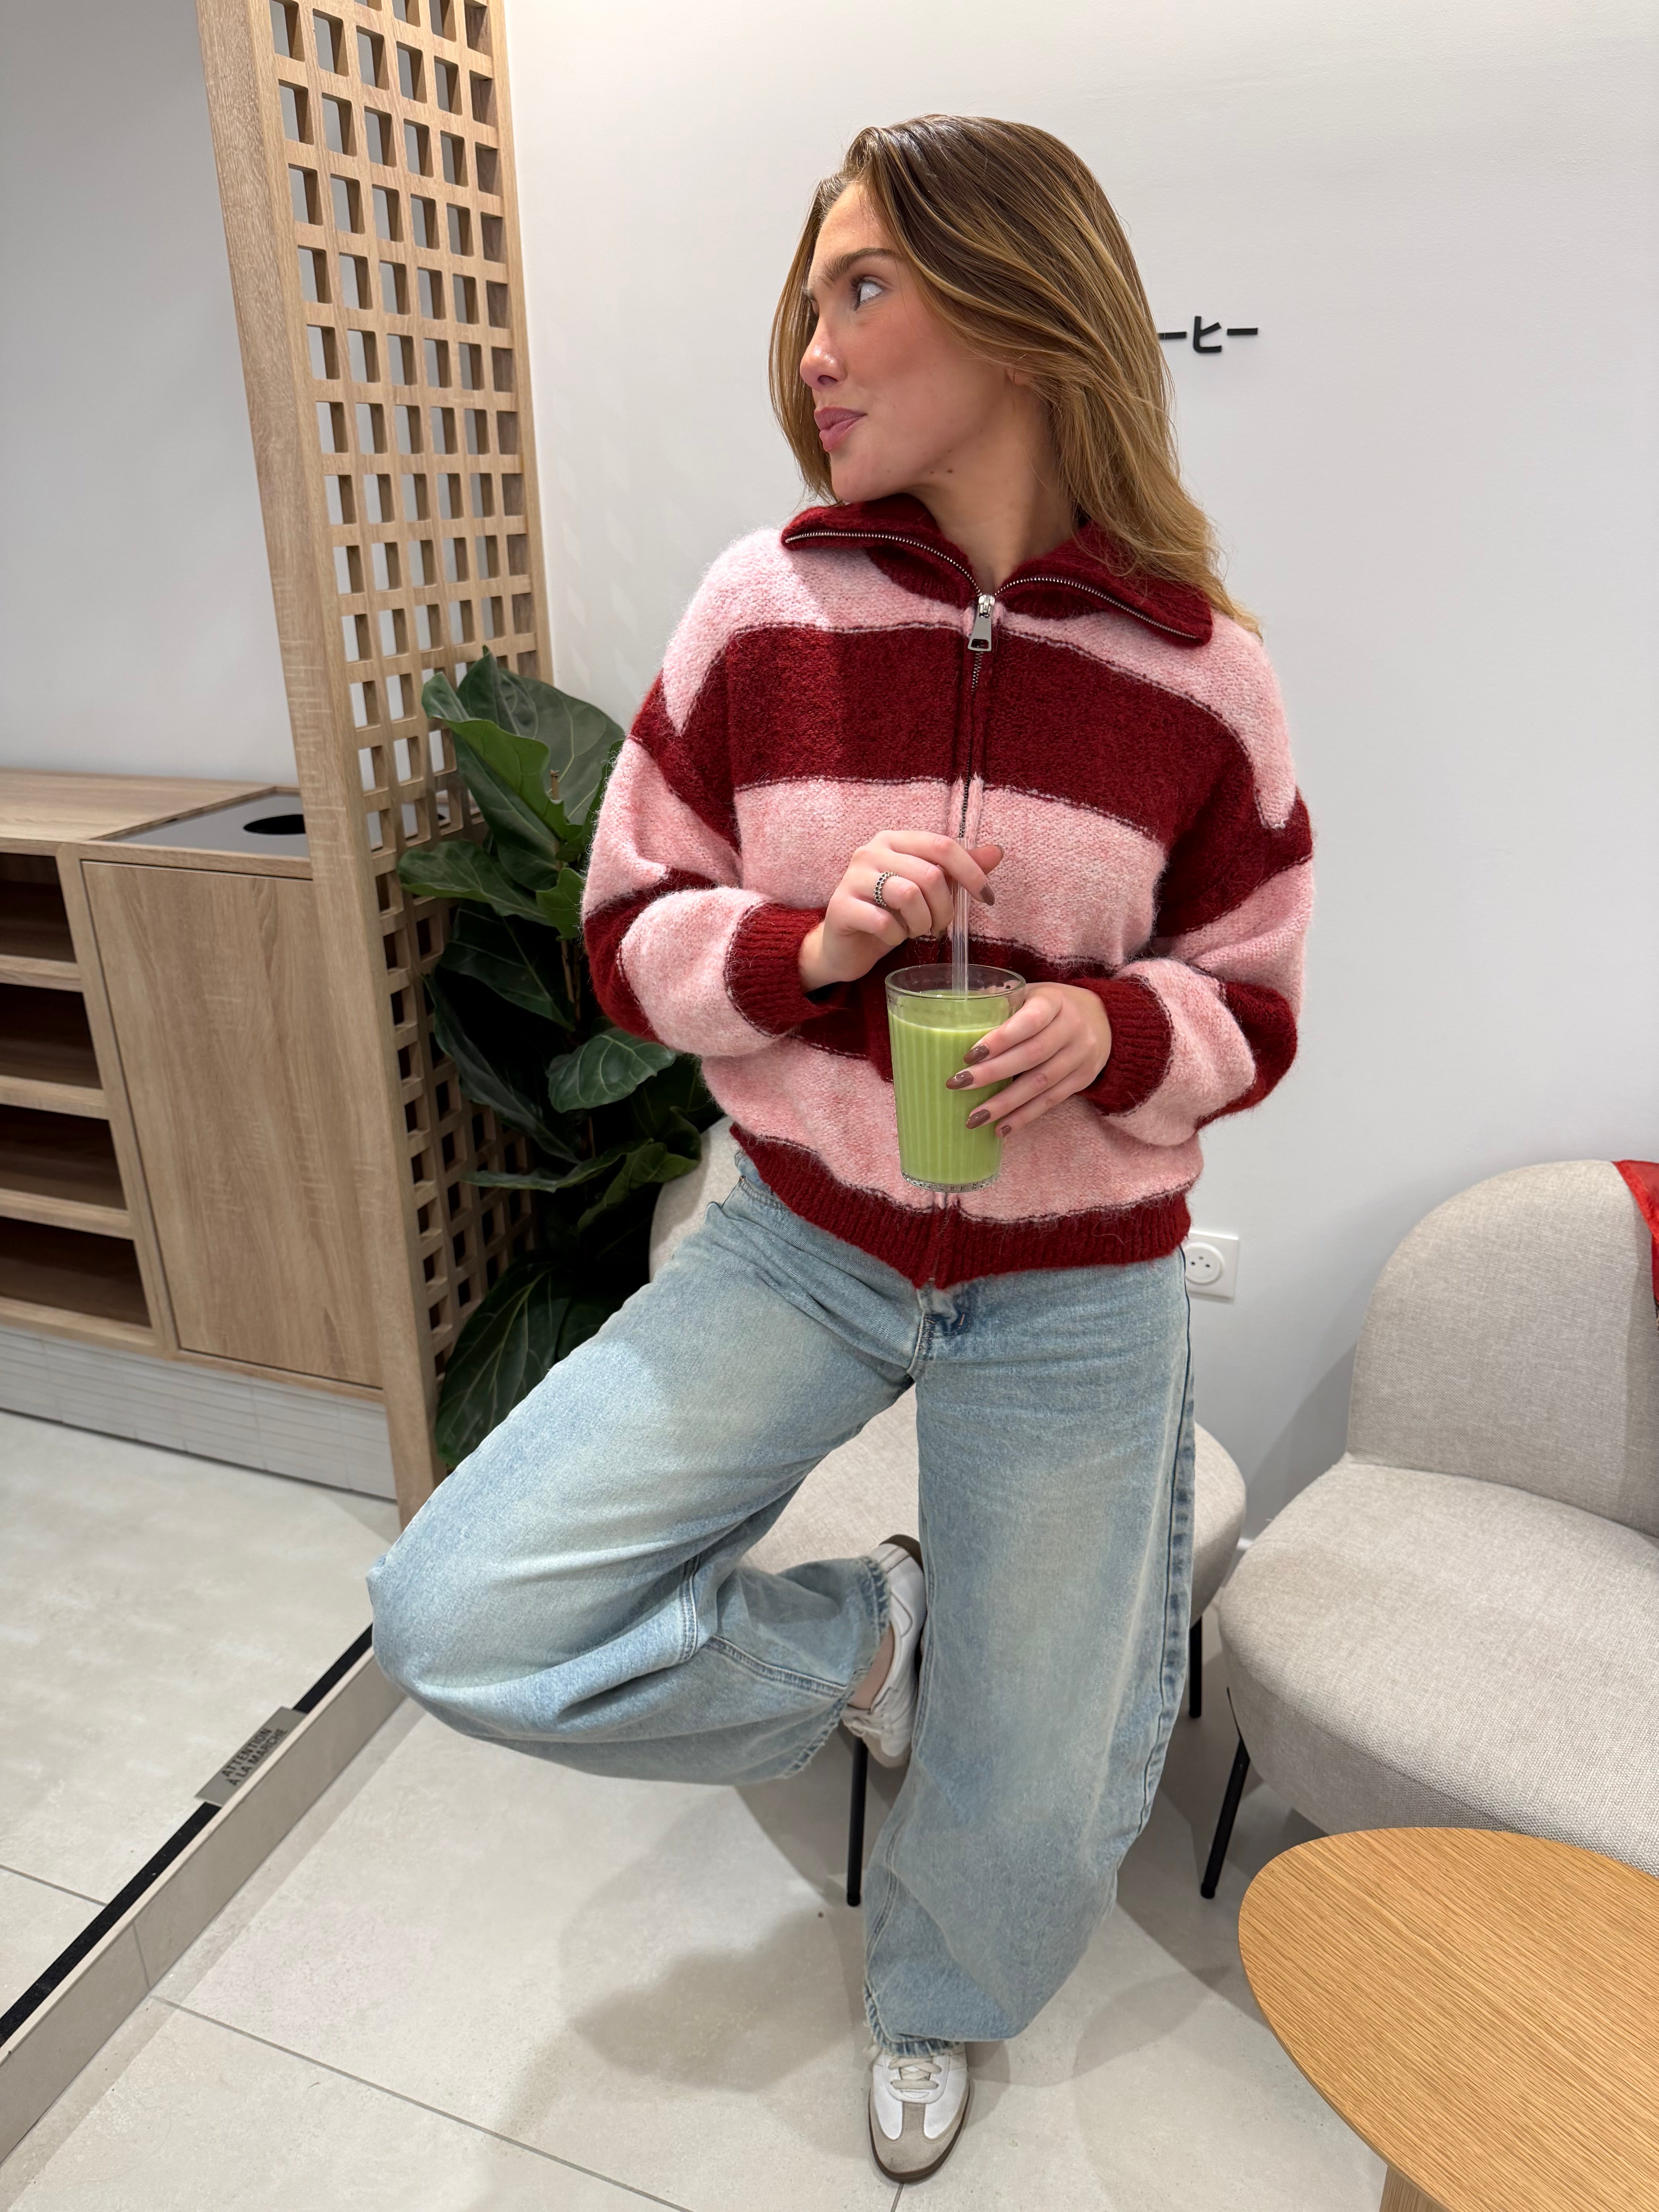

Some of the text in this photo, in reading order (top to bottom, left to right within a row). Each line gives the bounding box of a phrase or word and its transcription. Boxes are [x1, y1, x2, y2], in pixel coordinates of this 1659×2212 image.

[222, 1728, 271, 1777] ATTENTION
[235, 1766, 252, 1778] LA
[248, 1728, 288, 1764] MARCHE
